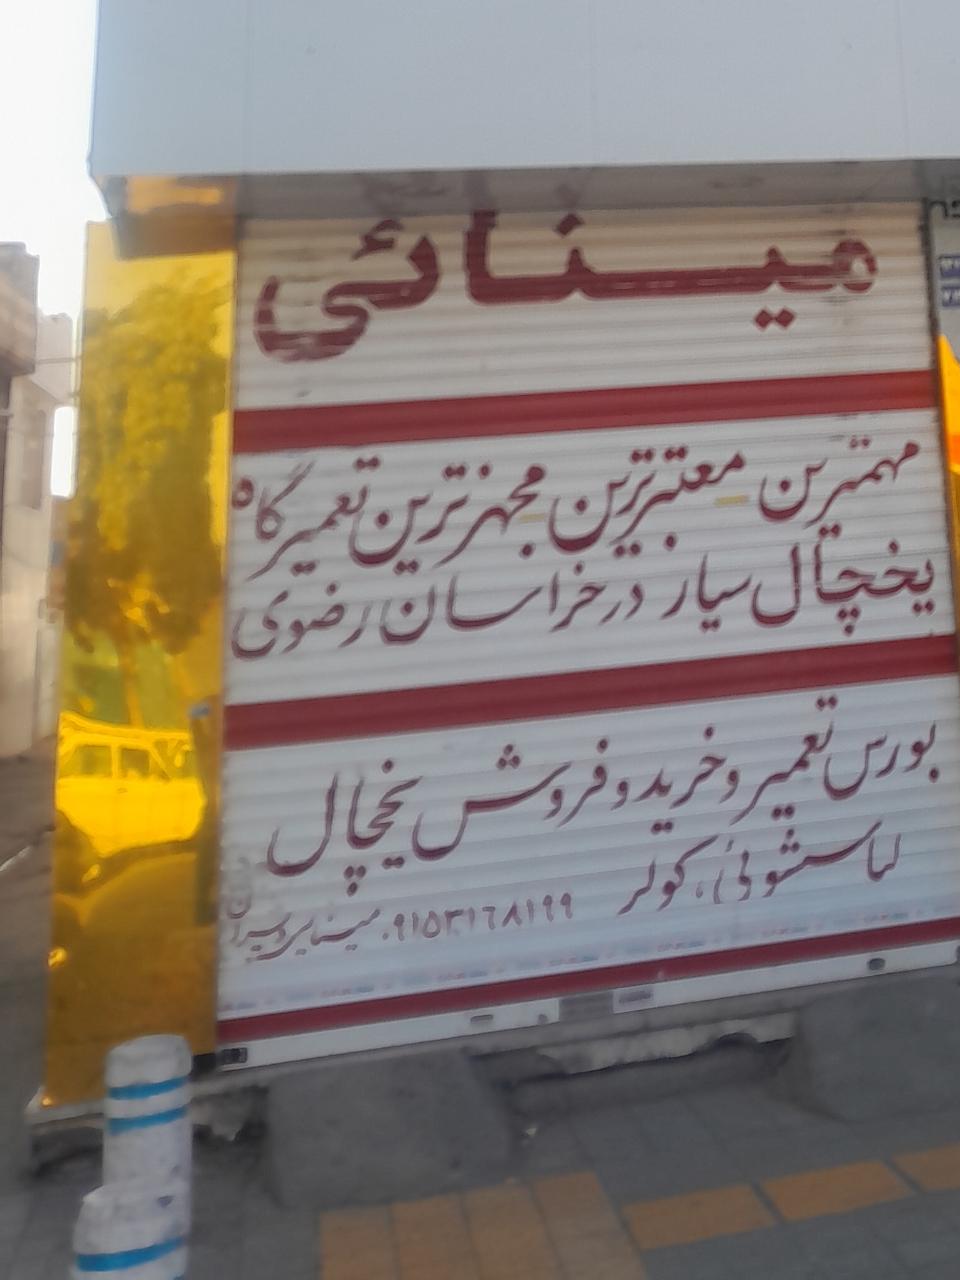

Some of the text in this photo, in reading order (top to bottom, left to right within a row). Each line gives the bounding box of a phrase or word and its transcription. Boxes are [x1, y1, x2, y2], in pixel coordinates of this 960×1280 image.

[253, 208, 879, 362] مینائی
[231, 581, 374, 658] رضوی
[378, 560, 606, 645] خراسان
[600, 582, 644, 625] در
[662, 552, 752, 631] سیار
[750, 539, 936, 635] یخچال
[411, 736, 609, 861] فروش
[632, 724, 727, 835] خرید
[728, 694, 839, 825] تعمیر
[823, 720, 937, 801] بورس
[266, 756, 425, 896] یخچال
[617, 833, 721, 916] کولر
